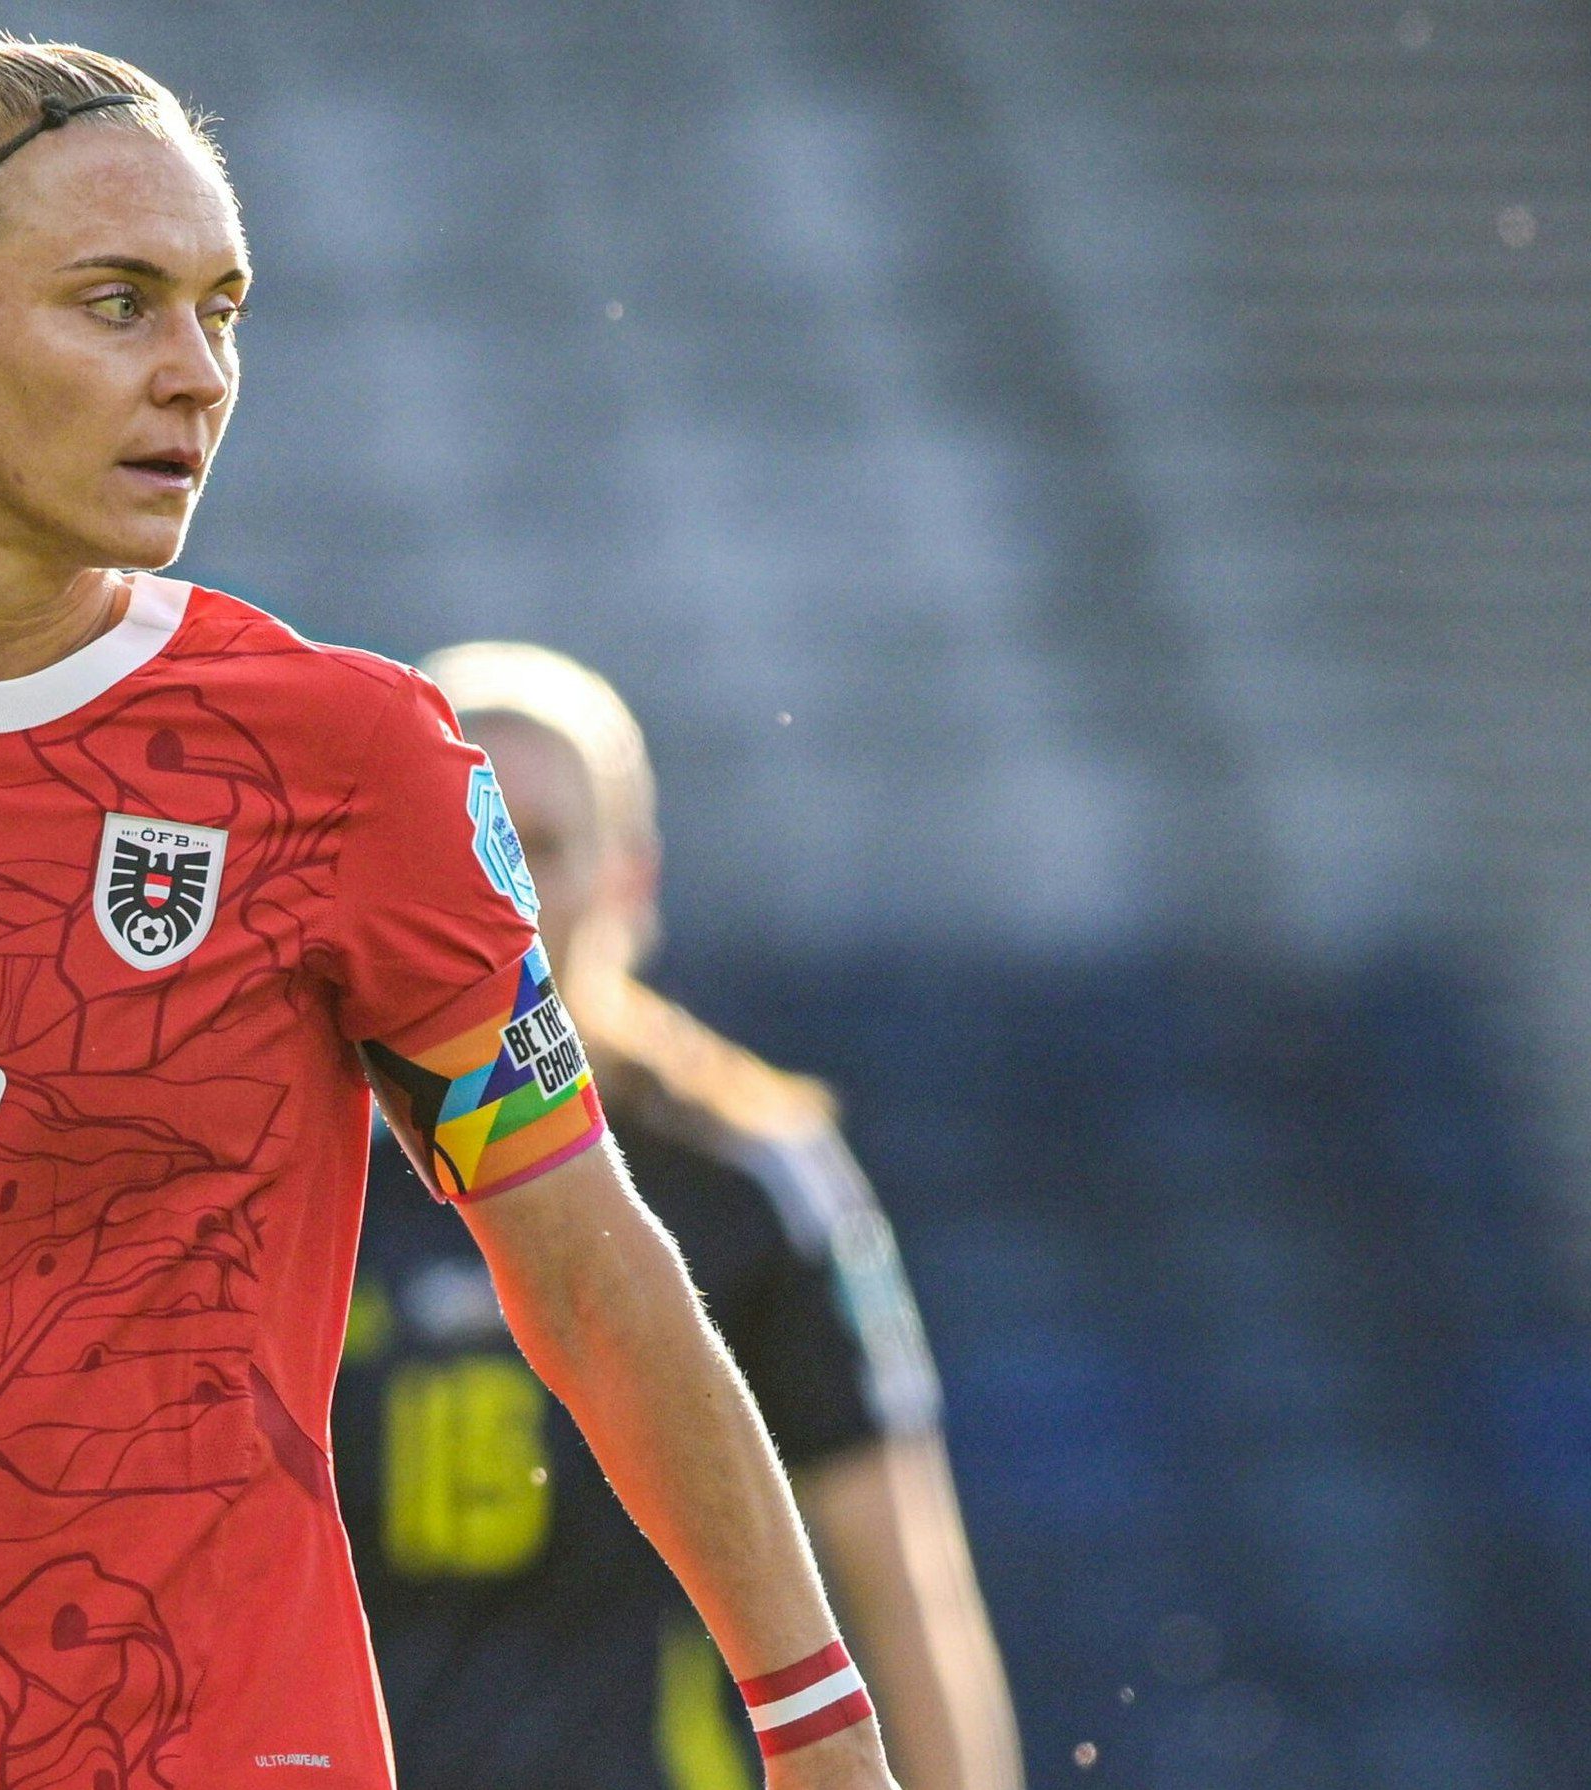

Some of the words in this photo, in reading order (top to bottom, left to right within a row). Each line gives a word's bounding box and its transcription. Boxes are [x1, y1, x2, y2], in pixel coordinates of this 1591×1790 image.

[140, 827, 190, 848] ÖFB
[504, 1024, 542, 1065] BE
[531, 997, 568, 1046] THE
[254, 1753, 332, 1769] ULTRAWEAVE
